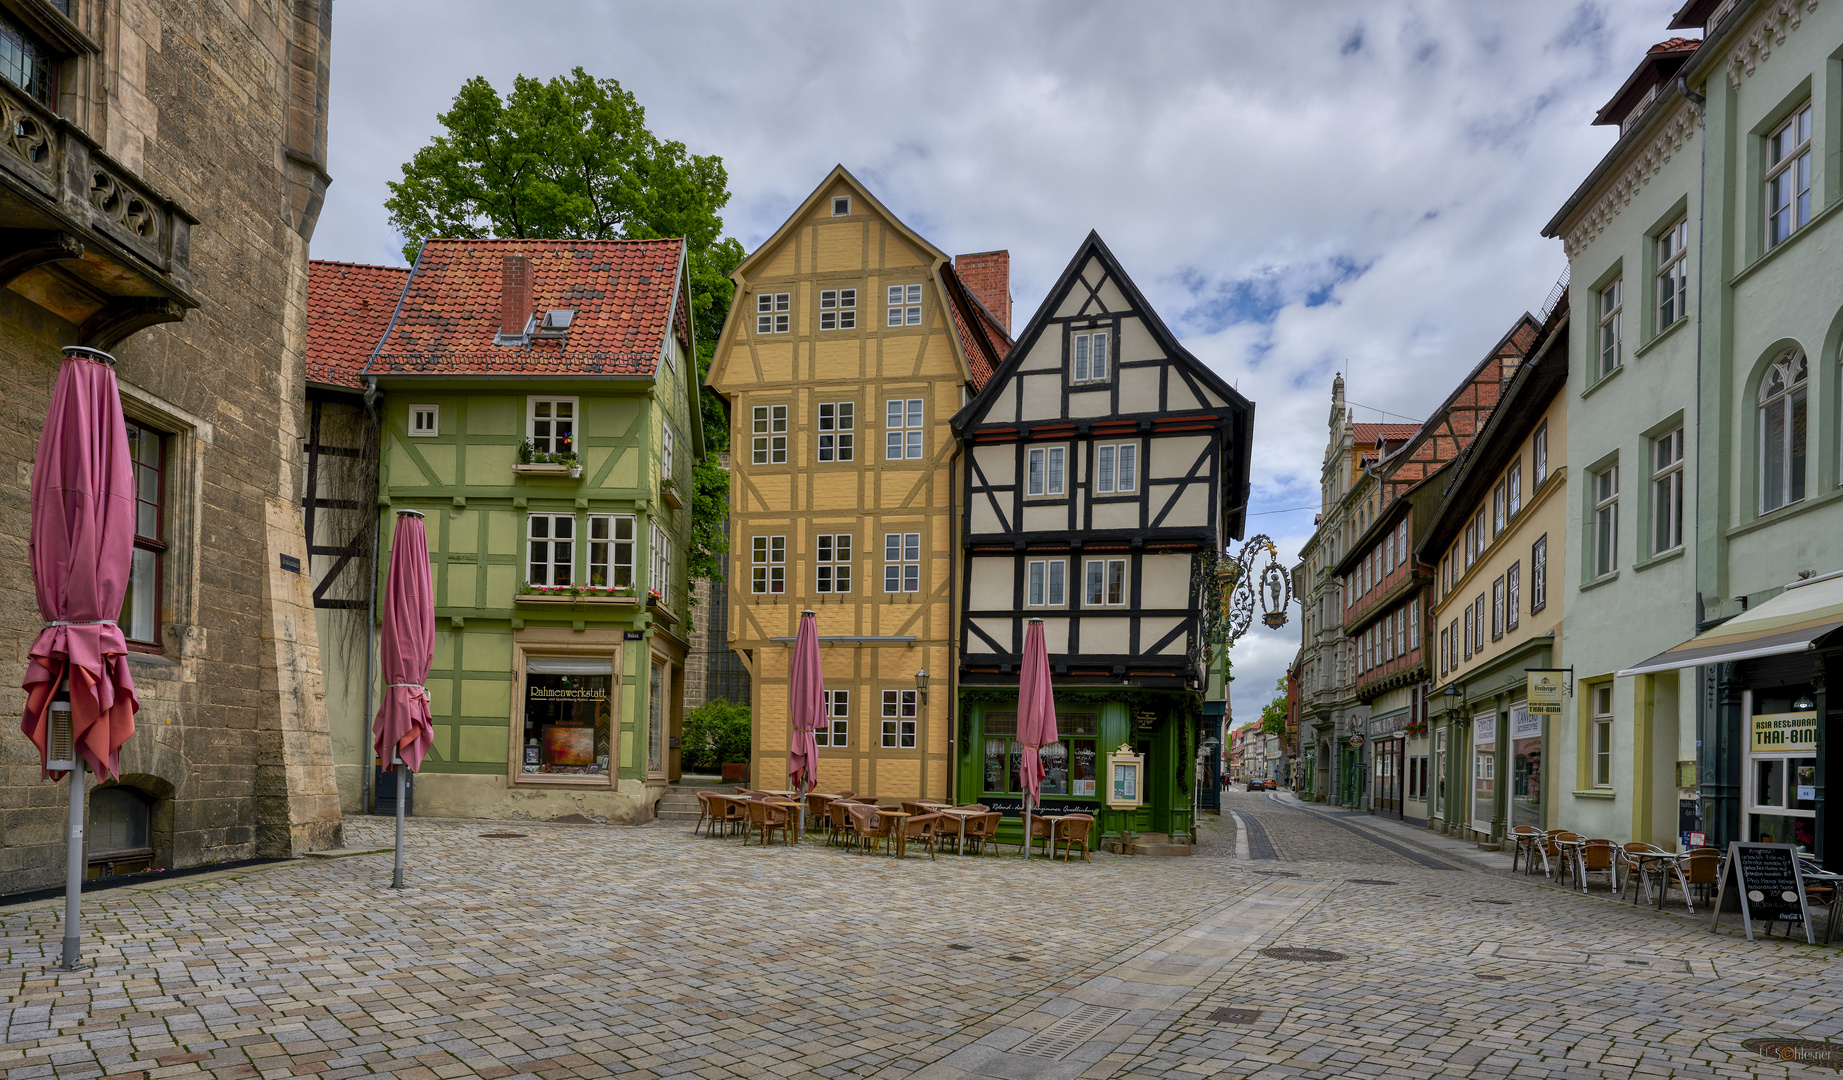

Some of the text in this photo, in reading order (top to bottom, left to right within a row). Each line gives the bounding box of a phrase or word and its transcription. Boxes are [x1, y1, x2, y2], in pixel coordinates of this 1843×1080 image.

[530, 686, 606, 698] Rahmenwerkstatt
[1534, 685, 1557, 693] Freiberger
[1756, 718, 1817, 730] ASIA RESTAURAN
[992, 803, 1012, 813] Roland
[1063, 804, 1095, 814] Quedlinbur
